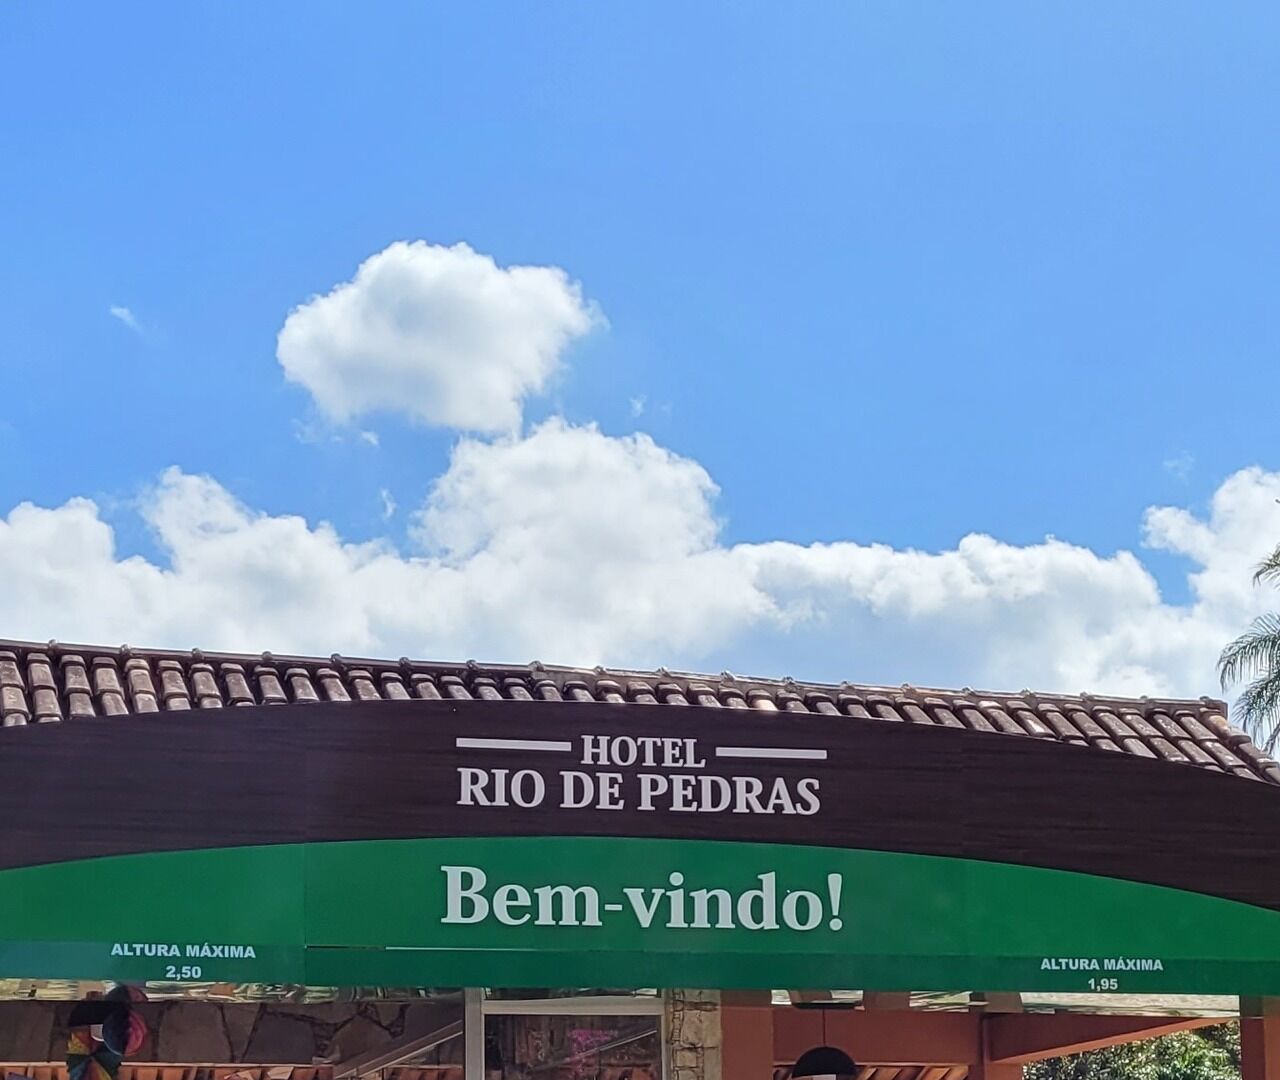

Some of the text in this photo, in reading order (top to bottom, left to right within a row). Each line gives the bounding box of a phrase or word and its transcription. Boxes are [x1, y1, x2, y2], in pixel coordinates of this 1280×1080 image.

[580, 734, 706, 768] HOTEL
[456, 767, 821, 815] RIO DE PEDRAS
[440, 865, 843, 932] Bem-vindo!
[111, 942, 256, 958] ALTURA MÁXIMA
[1040, 956, 1164, 971] ALTURA MÁXIMA
[165, 965, 202, 980] 2,50
[1088, 978, 1119, 992] 1,95
